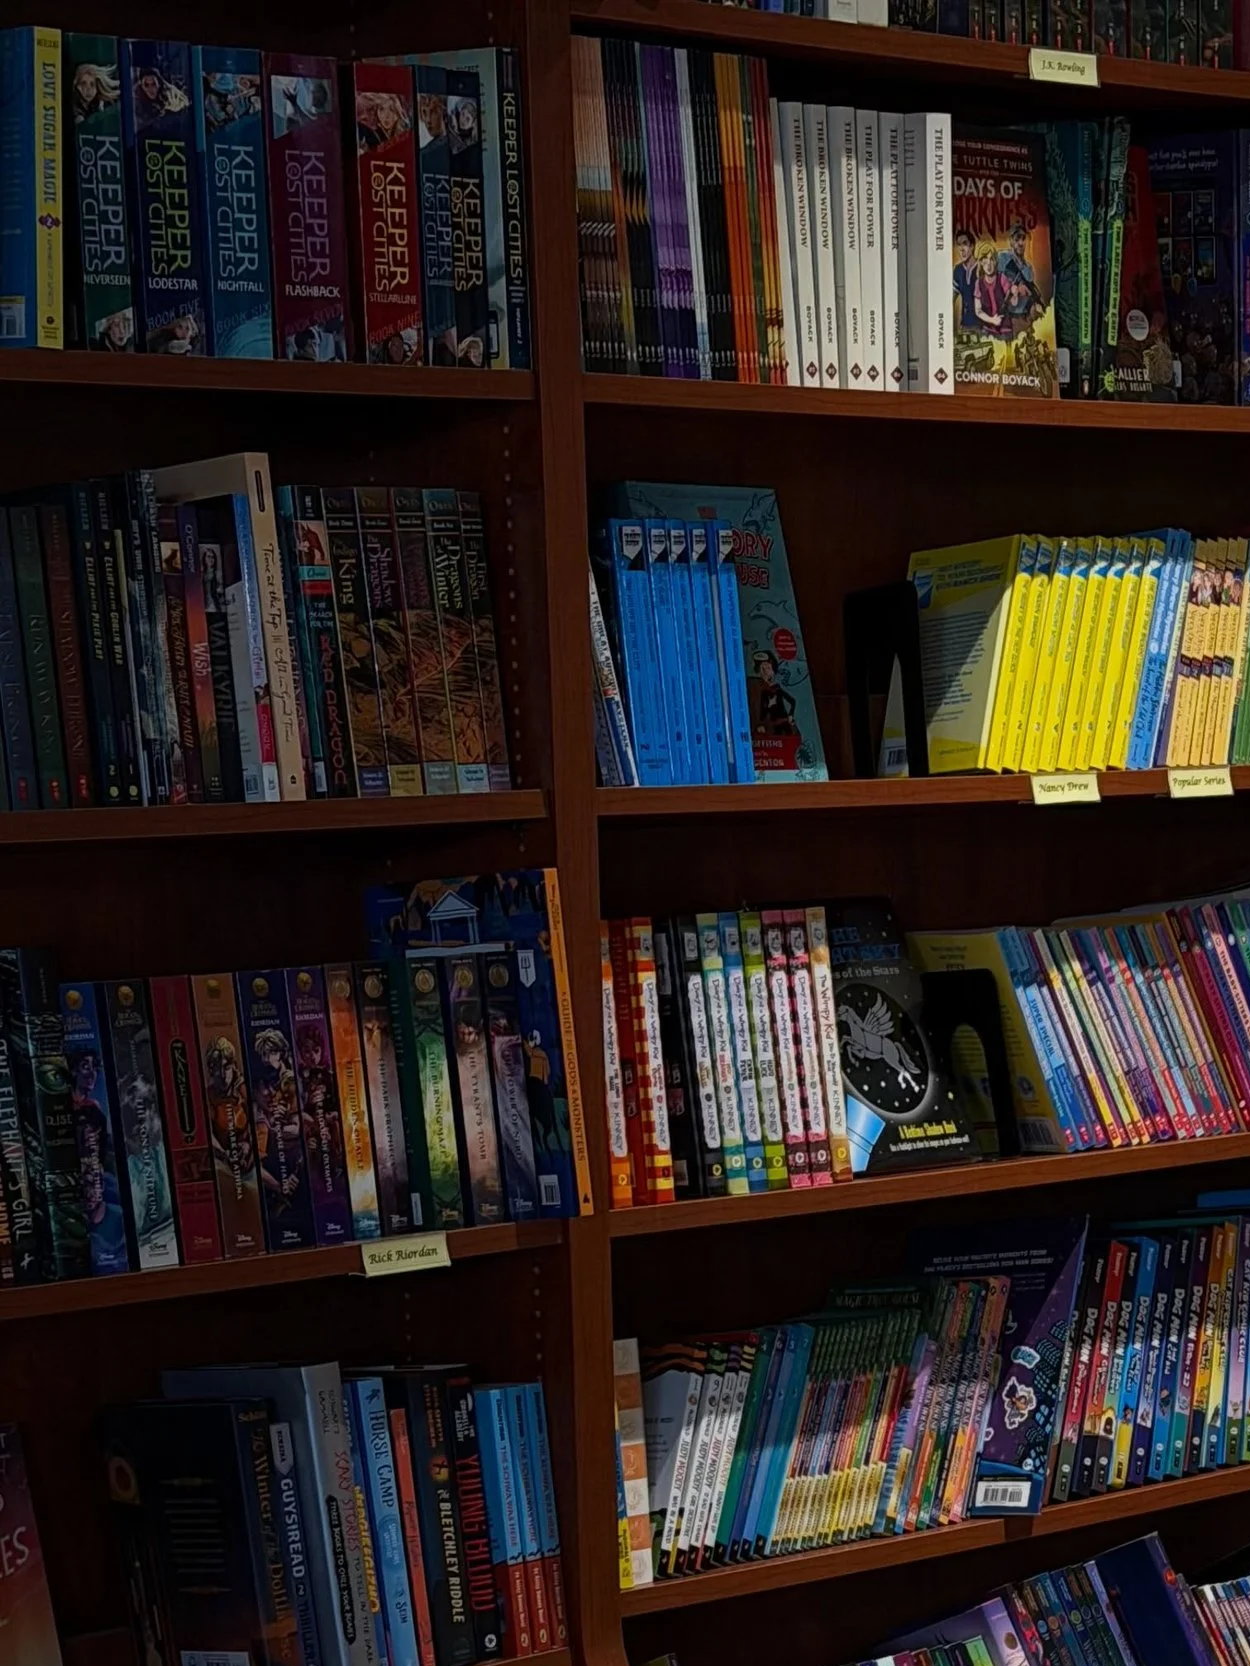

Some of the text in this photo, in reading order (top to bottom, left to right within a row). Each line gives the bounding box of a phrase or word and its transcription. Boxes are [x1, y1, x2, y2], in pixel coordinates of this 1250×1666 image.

[845, 147, 854, 195] BROKEN
[935, 154, 944, 183] PLAY
[963, 156, 1033, 172] TUTTLE TWINS
[866, 181, 874, 205] FOR
[935, 184, 944, 208] FOR
[954, 176, 1024, 200] DAYS OF
[95, 135, 126, 272] KEEPER
[162, 141, 192, 276] KEEPER
[230, 145, 259, 277] KEEPER
[846, 197, 856, 250] WINDOW
[866, 206, 875, 248] POWER
[935, 209, 945, 251] POWER
[148, 276, 198, 292] LODESTAR
[217, 279, 264, 293] NIGHTFALL
[285, 284, 341, 299] FLASHBACK
[955, 371, 1041, 387] CONNOR BOYACK
[338, 559, 357, 605] King
[1038, 777, 1090, 794] Nancy Drew
[367, 1244, 438, 1265] Rick Riordan
[440, 1501, 466, 1625] BLETCHLEY RIDDLE
